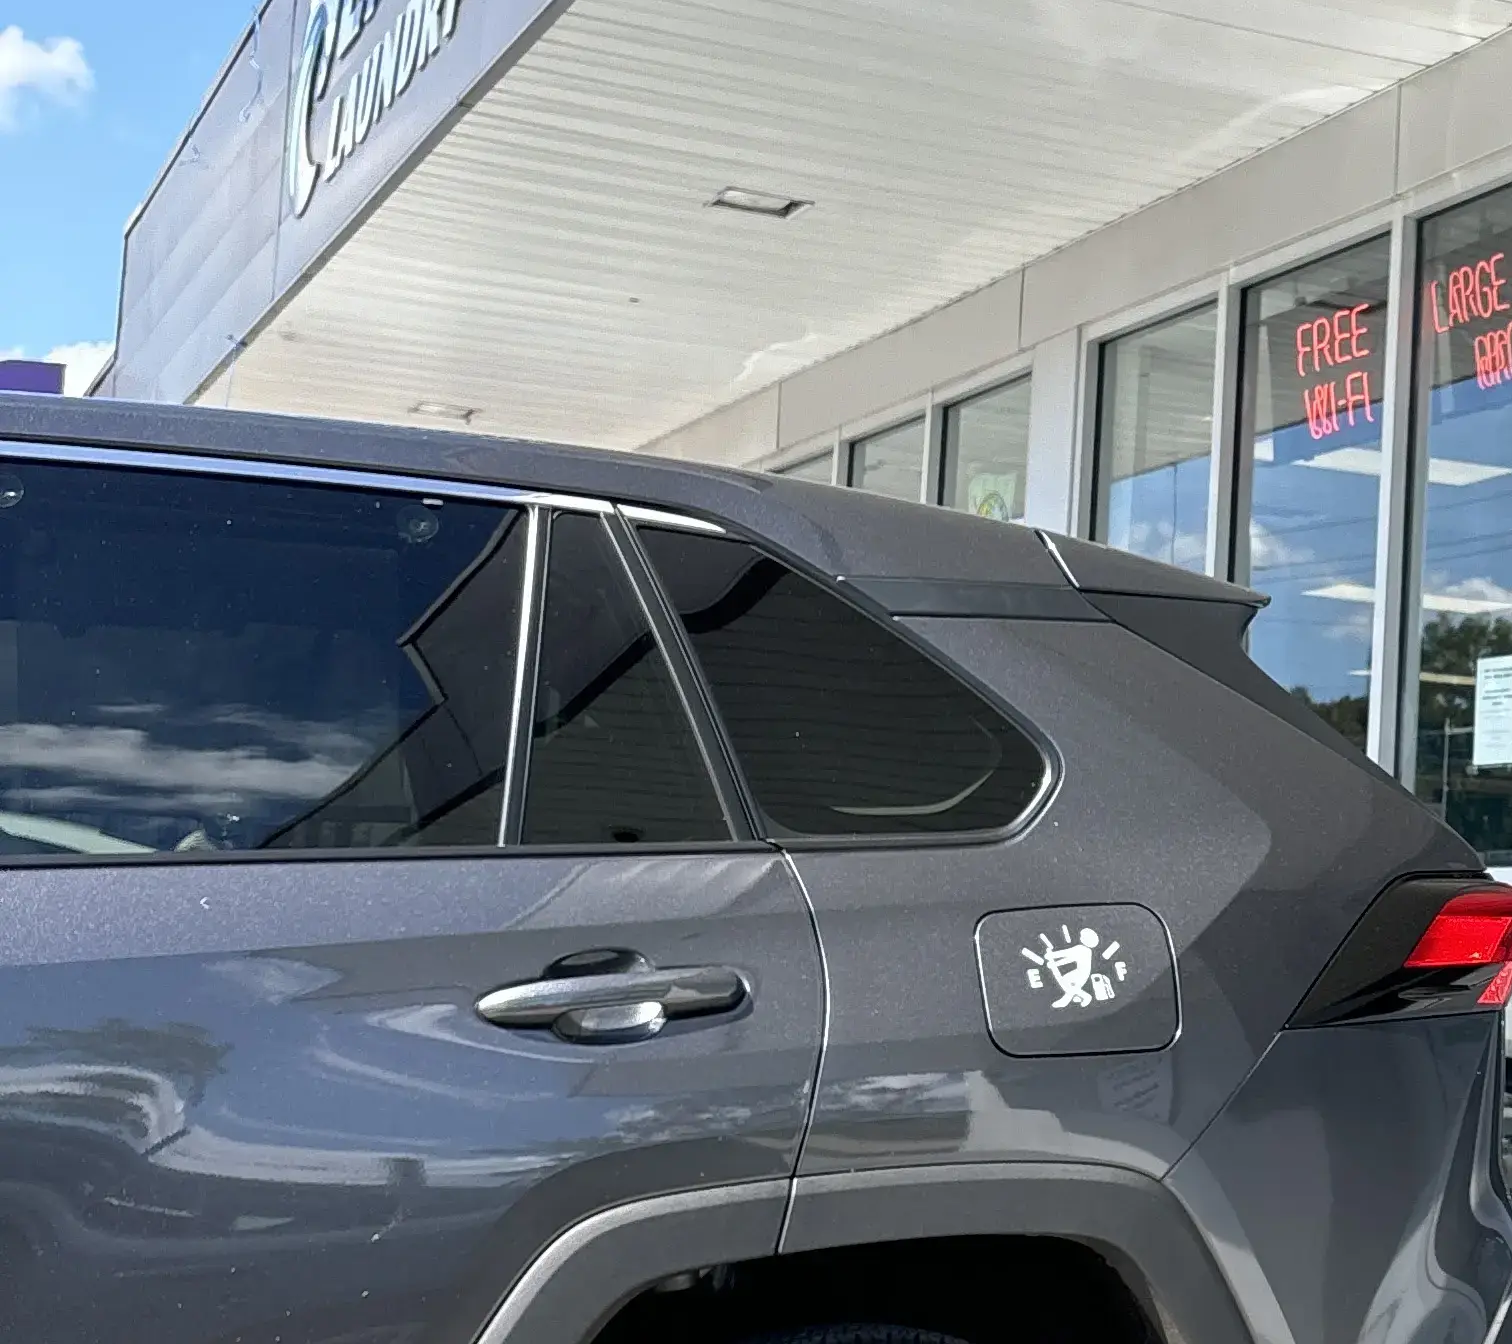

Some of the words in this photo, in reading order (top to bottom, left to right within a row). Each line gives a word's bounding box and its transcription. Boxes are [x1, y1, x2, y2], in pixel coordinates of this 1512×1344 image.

[1429, 253, 1510, 334] LARGE
[1296, 303, 1370, 377] FREE
[1304, 371, 1374, 440] WI-FI
[1027, 968, 1044, 989] E
[1114, 961, 1128, 981] F
